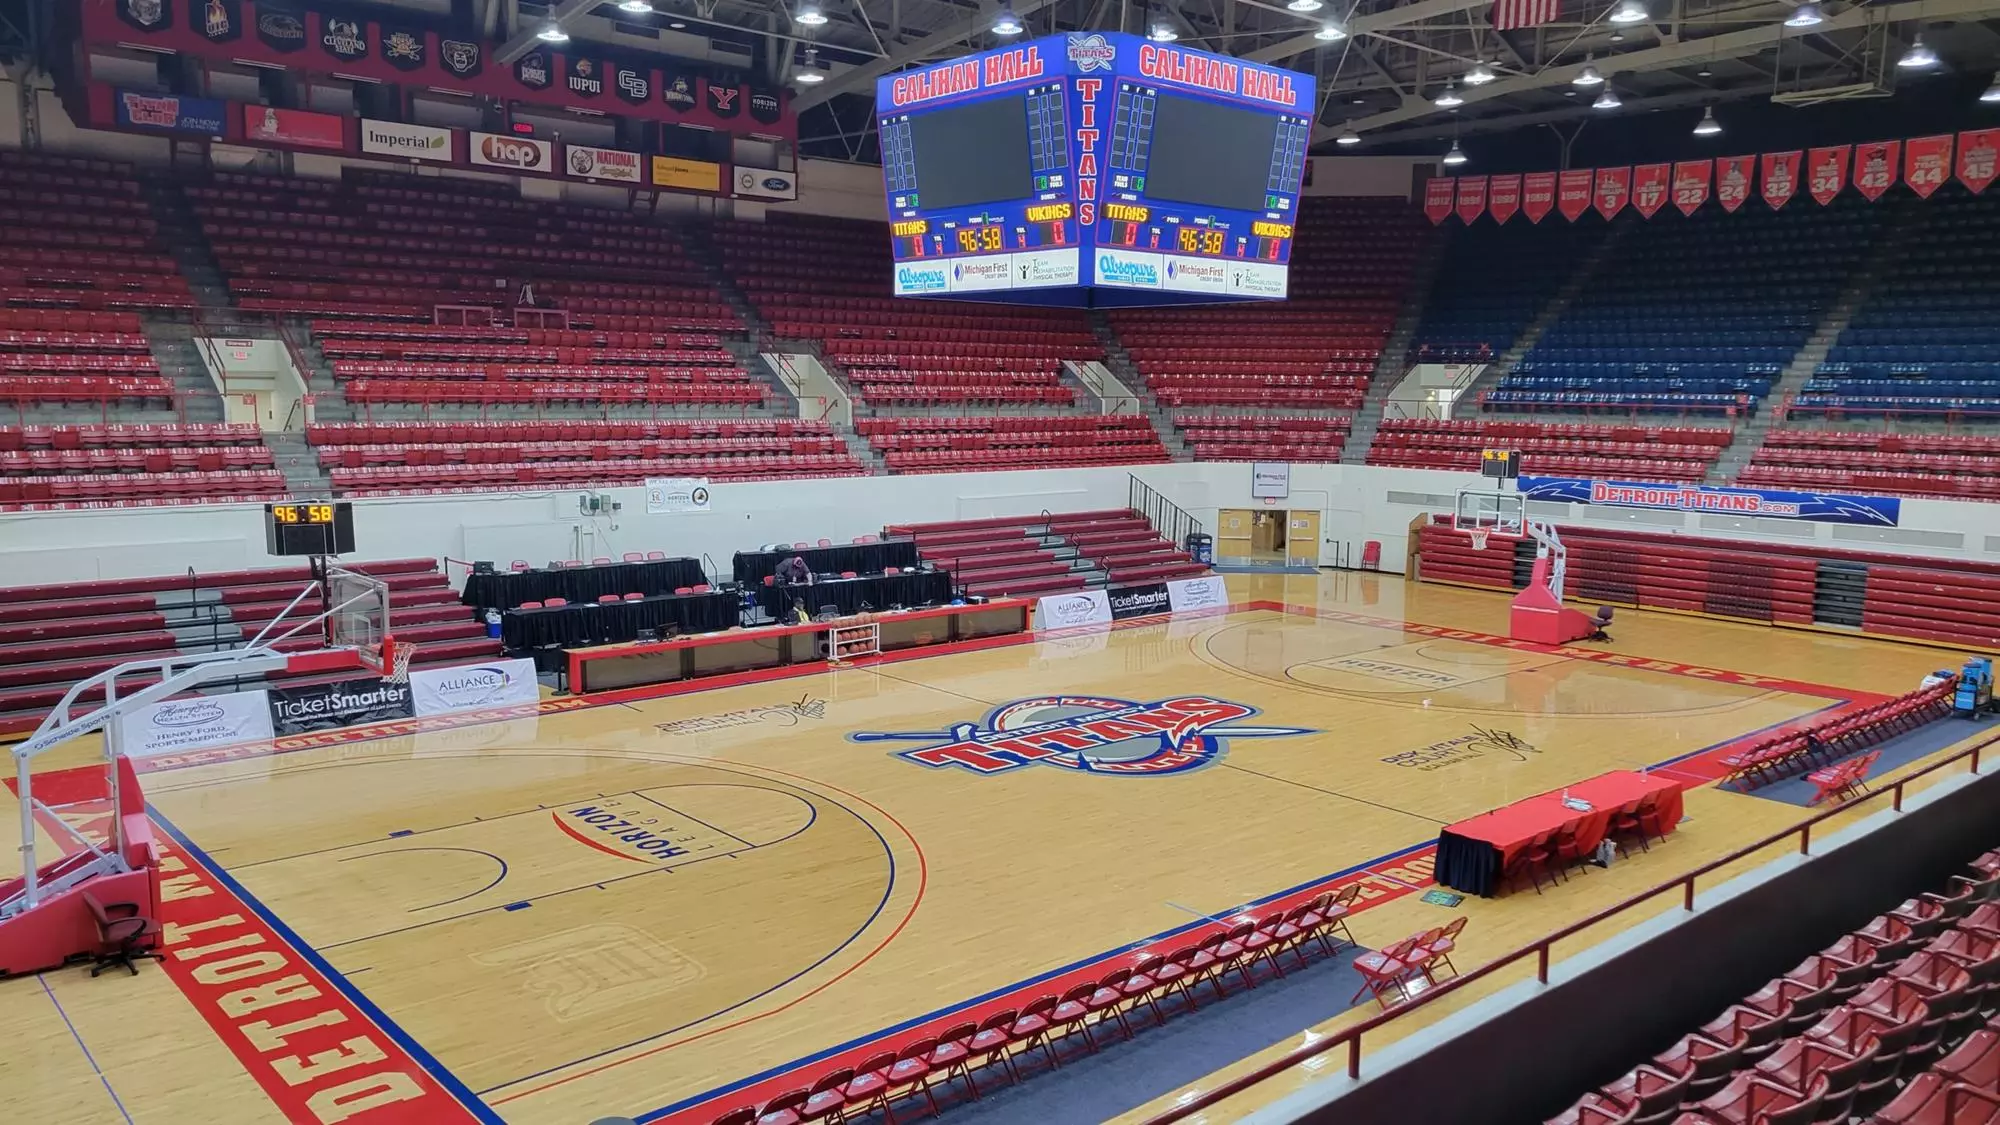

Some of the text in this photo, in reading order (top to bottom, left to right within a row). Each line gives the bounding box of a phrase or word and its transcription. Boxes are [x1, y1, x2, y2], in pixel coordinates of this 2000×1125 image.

[618, 69, 647, 98] GB
[893, 46, 1043, 106] CALIHAN HALL
[1139, 44, 1296, 106] CALIHAN HALL
[568, 76, 601, 93] IUPUI
[709, 85, 738, 109] Y
[752, 98, 777, 107] HORIZON
[369, 130, 429, 149] Imperial
[491, 137, 535, 167] hap
[596, 150, 636, 168] NATIONAL
[1077, 79, 1102, 225] TITANS
[1910, 167, 1941, 184] 44
[1963, 161, 1995, 179] 45
[767, 180, 785, 191] Ford
[1812, 177, 1839, 193] 34
[1860, 172, 1889, 188] 42
[1677, 189, 1702, 204] 22
[1719, 185, 1745, 200] 24
[1766, 182, 1791, 197] 32
[1604, 195, 1616, 208] 3
[1640, 192, 1659, 206] 17
[1027, 204, 1070, 221] VIKINGS
[1106, 204, 1148, 222] TITANS
[893, 220, 928, 236] TITANS
[1053, 220, 1065, 245] 0
[1125, 224, 1138, 245] 0
[1254, 221, 1291, 238] VIKINGS
[912, 235, 924, 256] 0
[959, 227, 1001, 251] 96:58
[1179, 229, 1224, 254] 96:58
[1270, 239, 1280, 259] 0
[964, 262, 1008, 276] Michigan First
[1179, 264, 1224, 277] Michigan First
[1593, 483, 1797, 515] DETROITTITANS.COM
[274, 506, 332, 522] 96:58
[1110, 591, 1168, 610] TicketSmarter
[1339, 658, 1458, 684] HORIZON
[1555, 647, 1785, 684] MERCY
[439, 675, 495, 691] ALLIANCE
[274, 687, 408, 718] TicketSmarter
[80, 714, 111, 730] Sports
[157, 714, 189, 722] HEALTH
[980, 704, 1148, 743] DETROIT MERCY
[145, 732, 238, 749] SPORTS MEDICINE
[156, 730, 193, 740] HENRY
[903, 697, 1254, 773] TITANS
[1381, 750, 1417, 763] DICK
[567, 806, 690, 859] HORIZON
[604, 800, 714, 851] LEAGUE
[163, 913, 427, 1125] DETROIT
